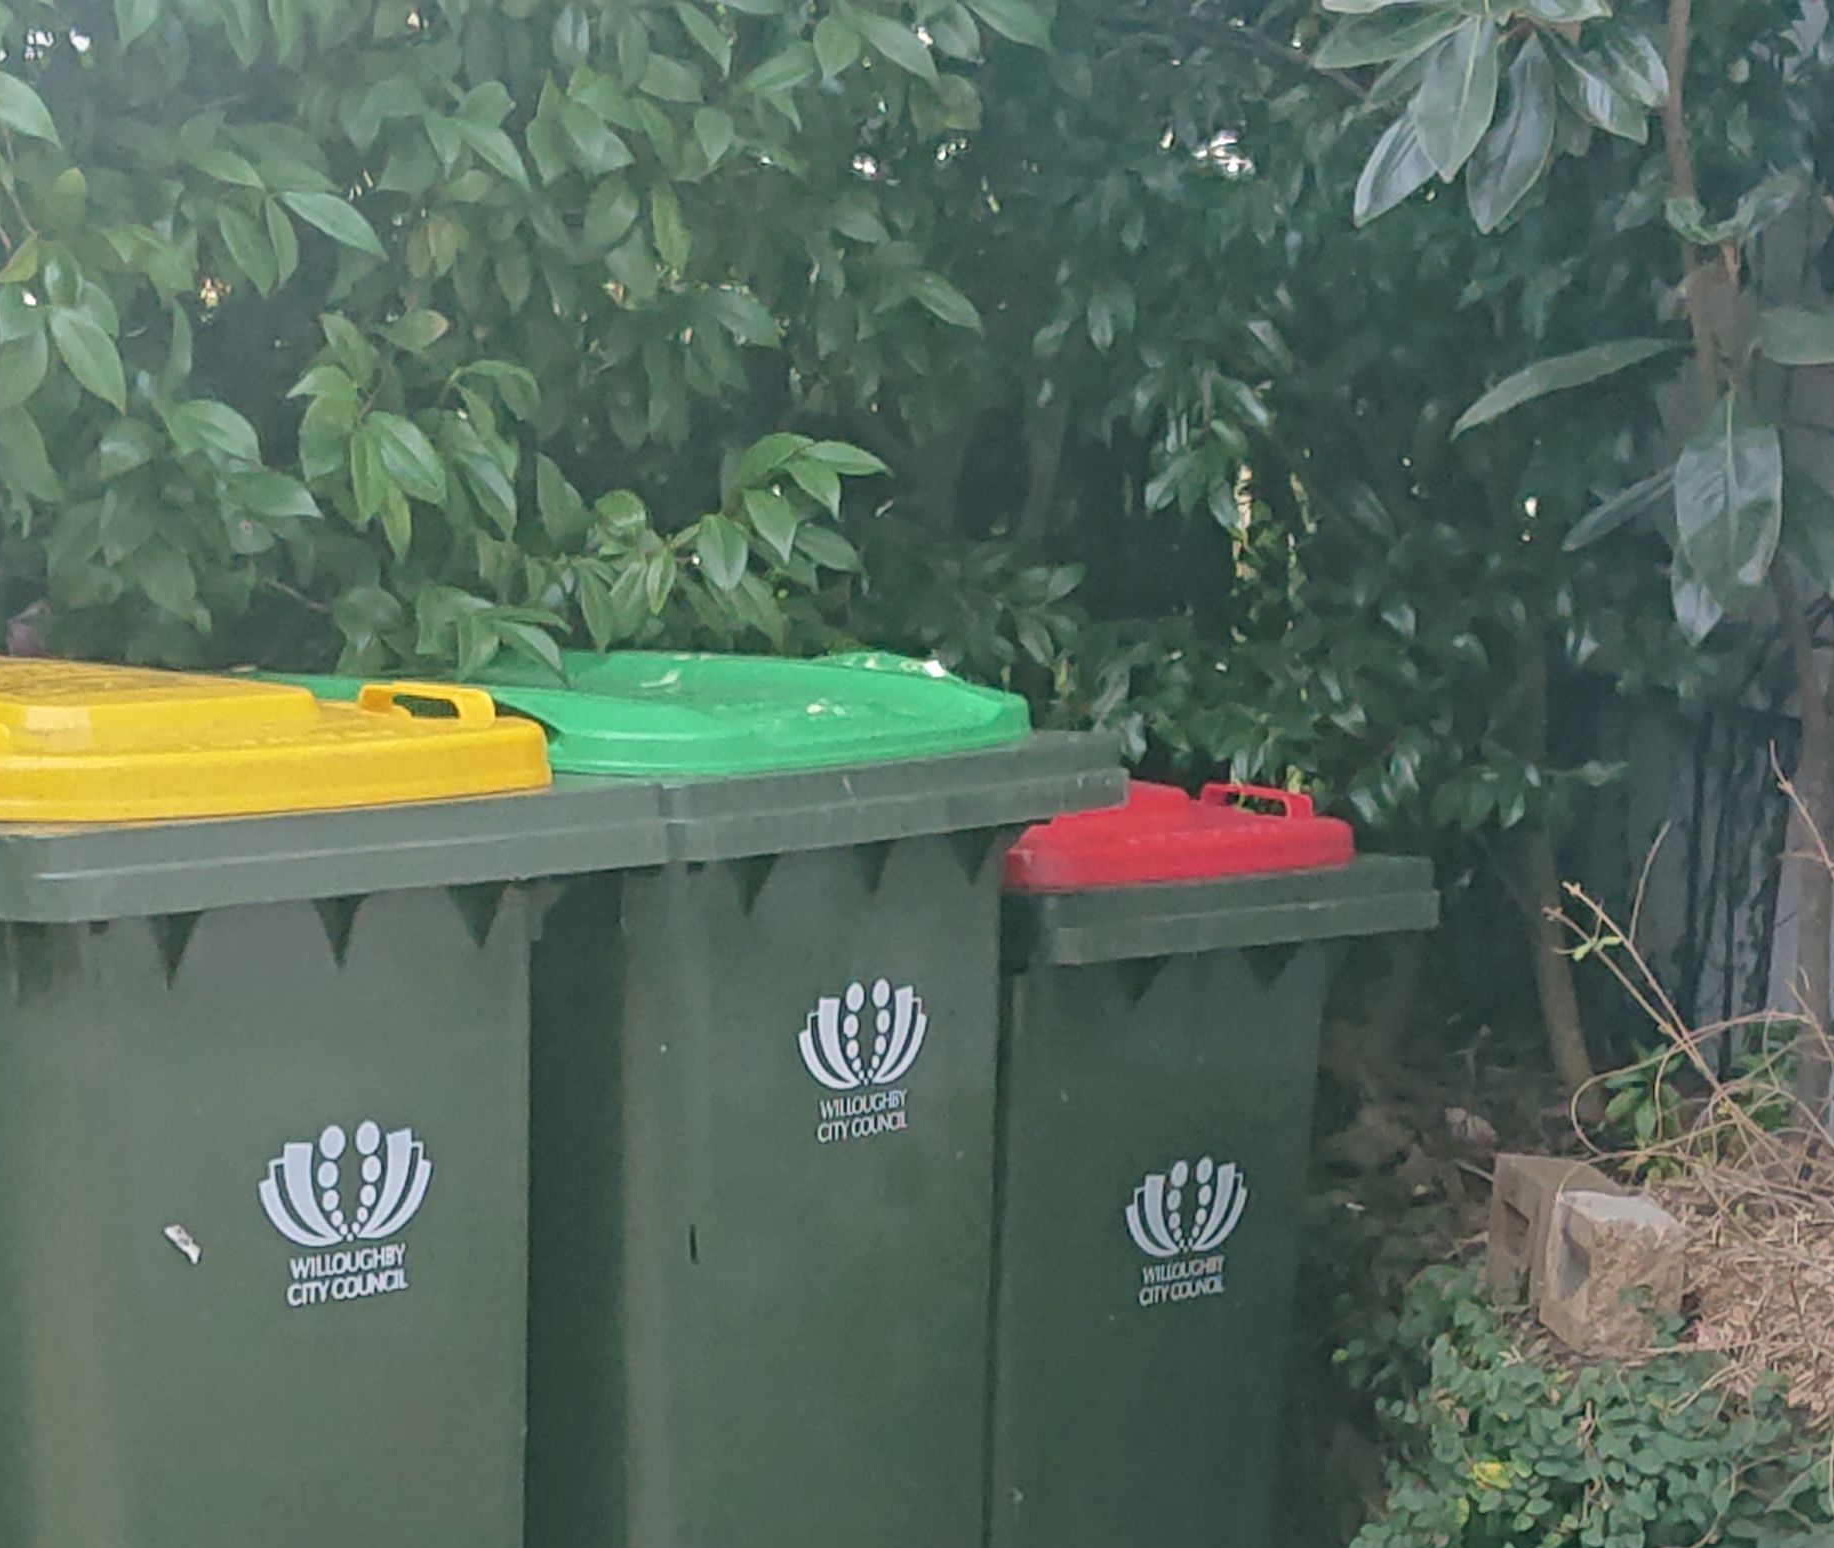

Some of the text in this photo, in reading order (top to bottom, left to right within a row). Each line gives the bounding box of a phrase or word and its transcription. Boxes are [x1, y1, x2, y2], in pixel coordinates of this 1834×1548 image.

[820, 1089, 907, 1119] WILLOUGHBY
[817, 1110, 908, 1143] CITY COUNCIL
[290, 1243, 406, 1280] WILLOUGHBY
[1142, 1254, 1225, 1284] WILLOUGHBY
[286, 1269, 409, 1307] CITY COUNCIL
[1138, 1274, 1225, 1306] CITY COUNCIL
